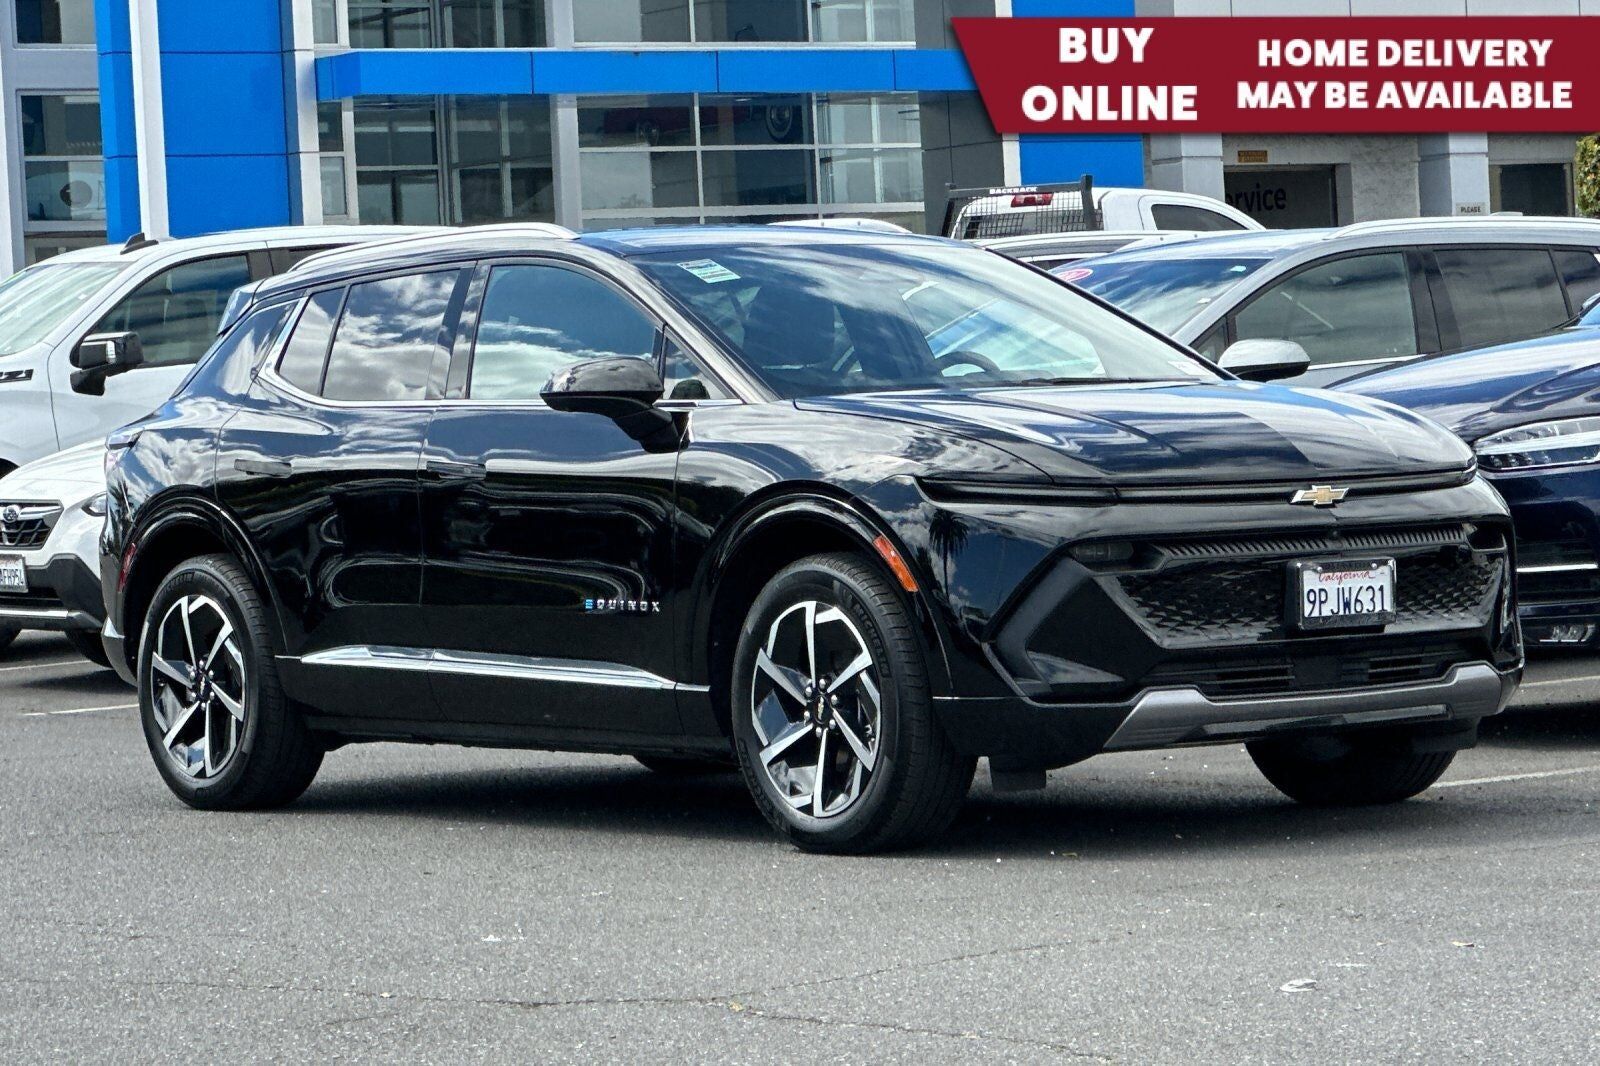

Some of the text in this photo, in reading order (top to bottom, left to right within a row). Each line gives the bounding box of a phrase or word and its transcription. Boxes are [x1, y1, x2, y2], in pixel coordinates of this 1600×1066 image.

[1318, 570, 1376, 585] California
[585, 598, 660, 612] EQUINOX
[1306, 585, 1388, 617] 9PJW631
